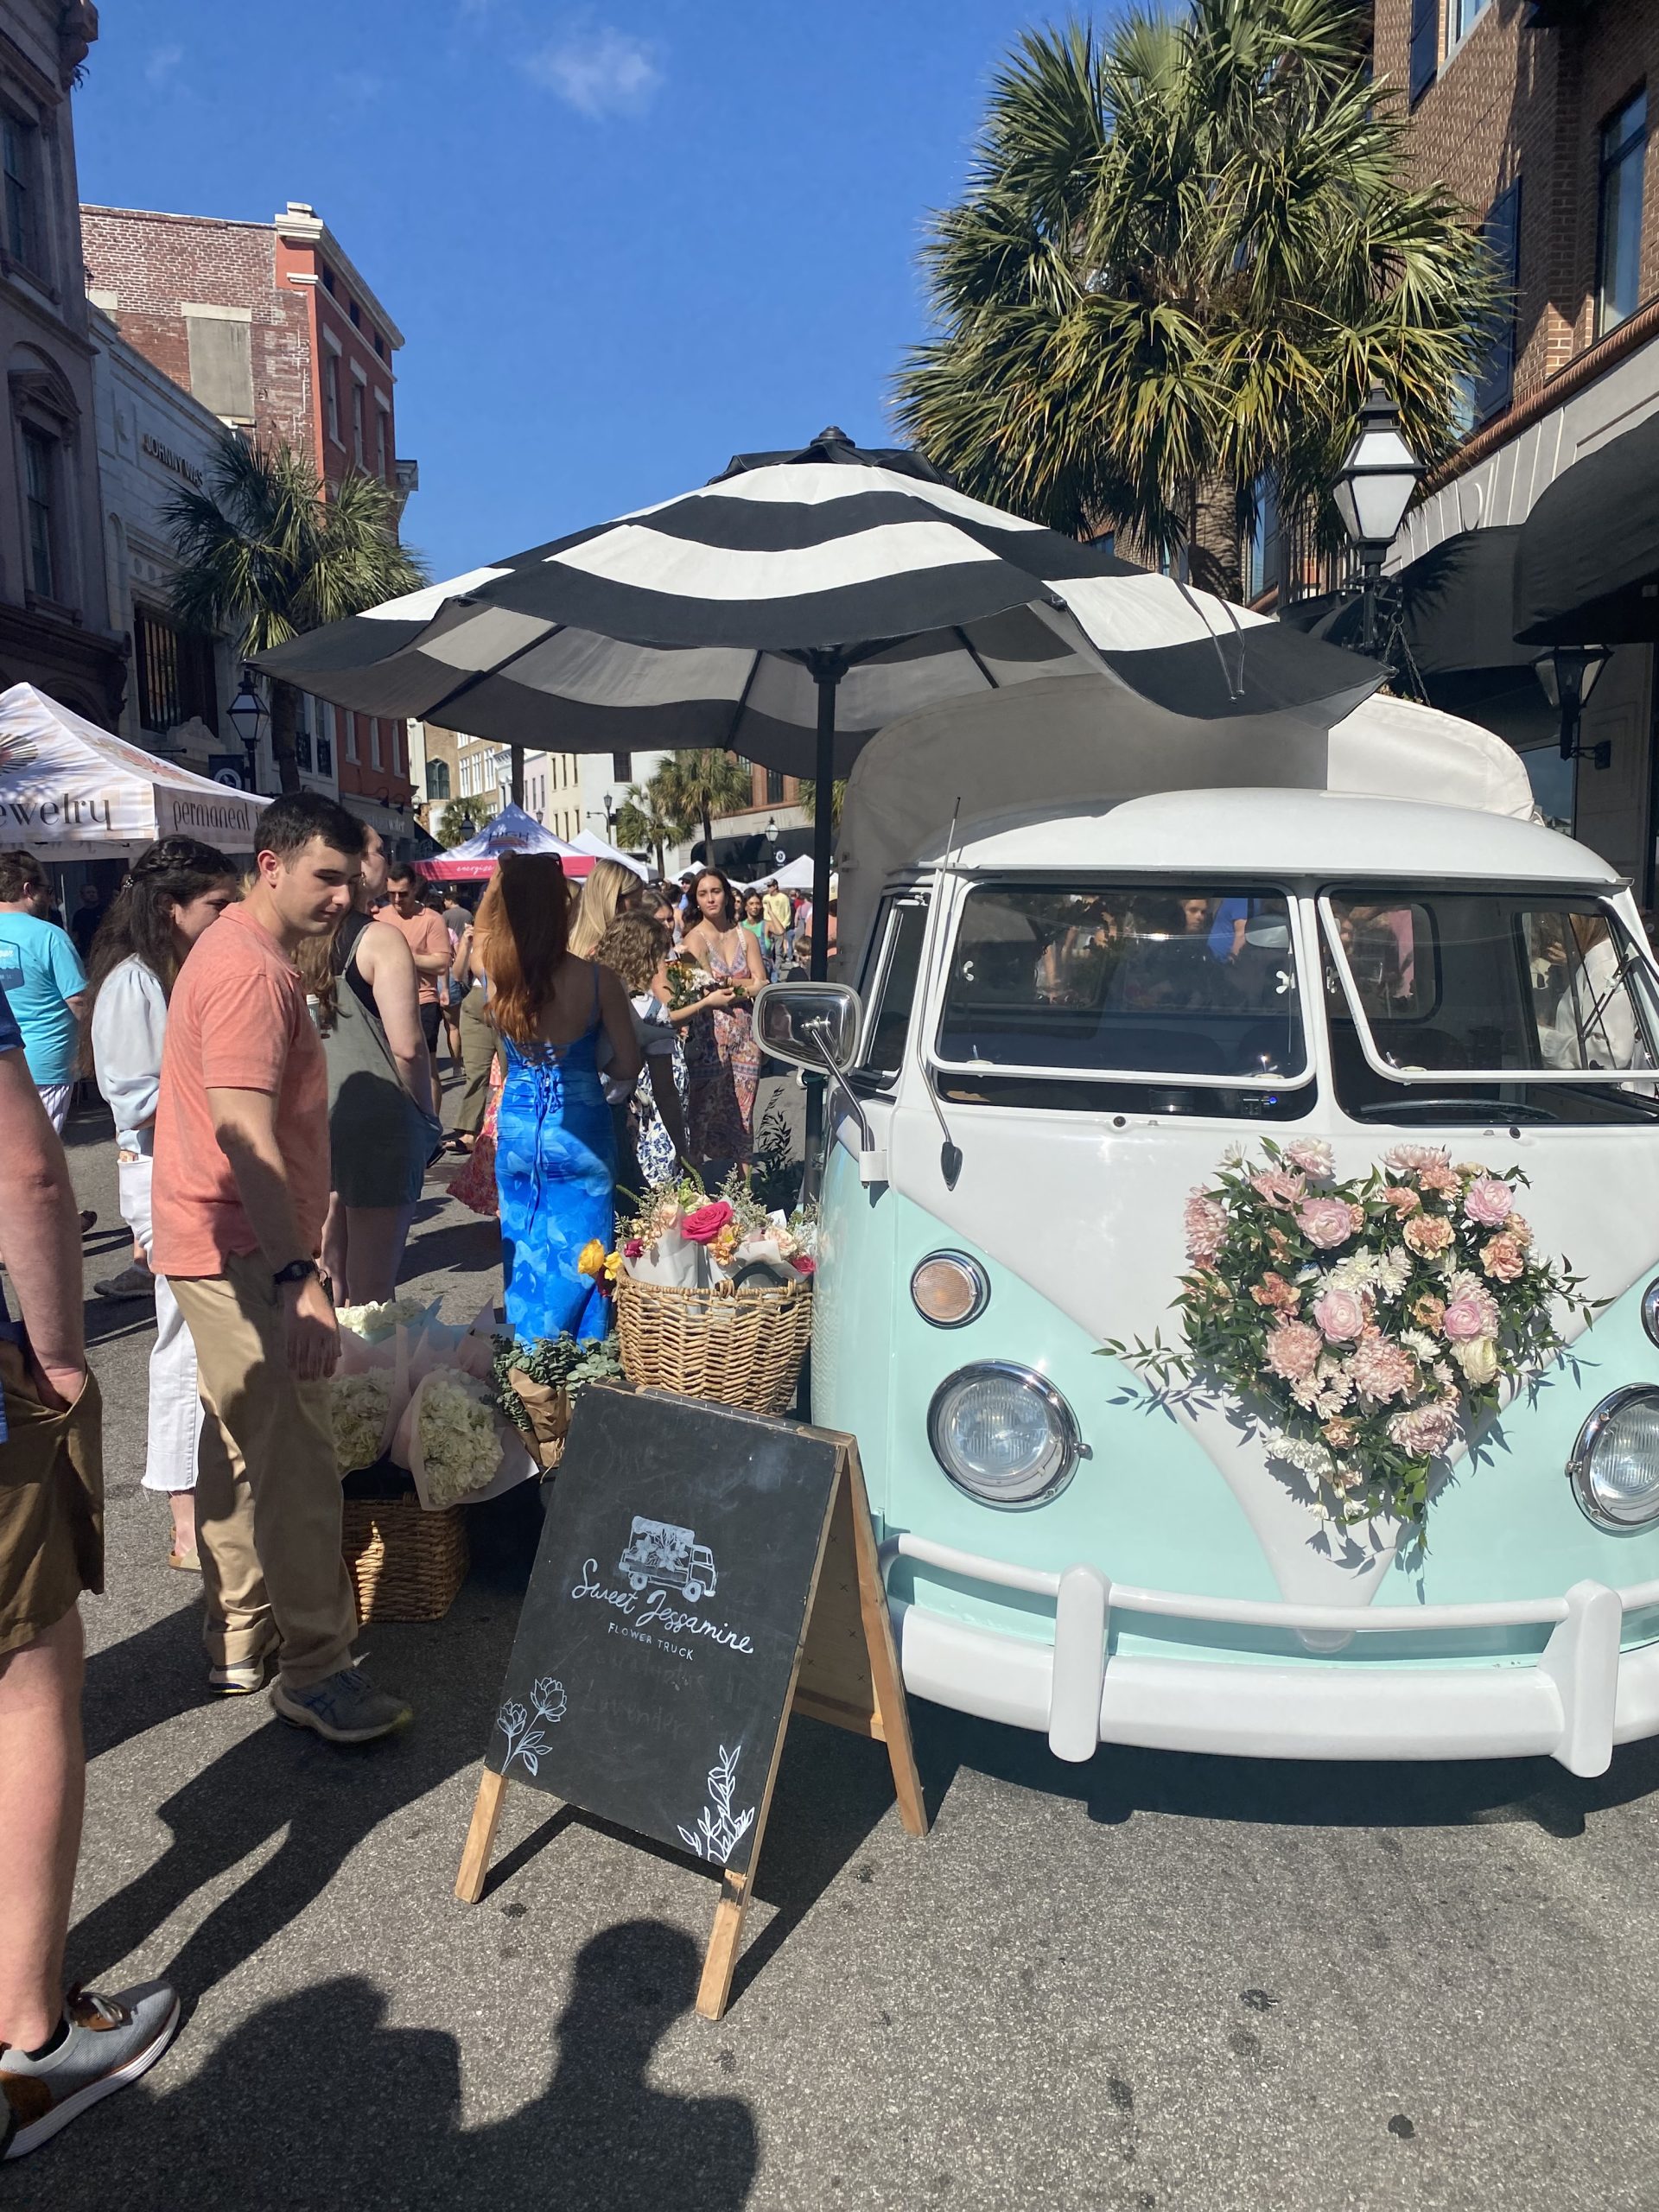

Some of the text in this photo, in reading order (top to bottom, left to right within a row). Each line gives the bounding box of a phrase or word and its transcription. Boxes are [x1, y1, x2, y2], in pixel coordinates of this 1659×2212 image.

[173, 800, 251, 831] permanent
[488, 830, 529, 842] HIGH
[456, 865, 494, 876] energize
[571, 1558, 753, 1654] Sweet Jessamine
[607, 1622, 694, 1661] FLOWER TRUCK
